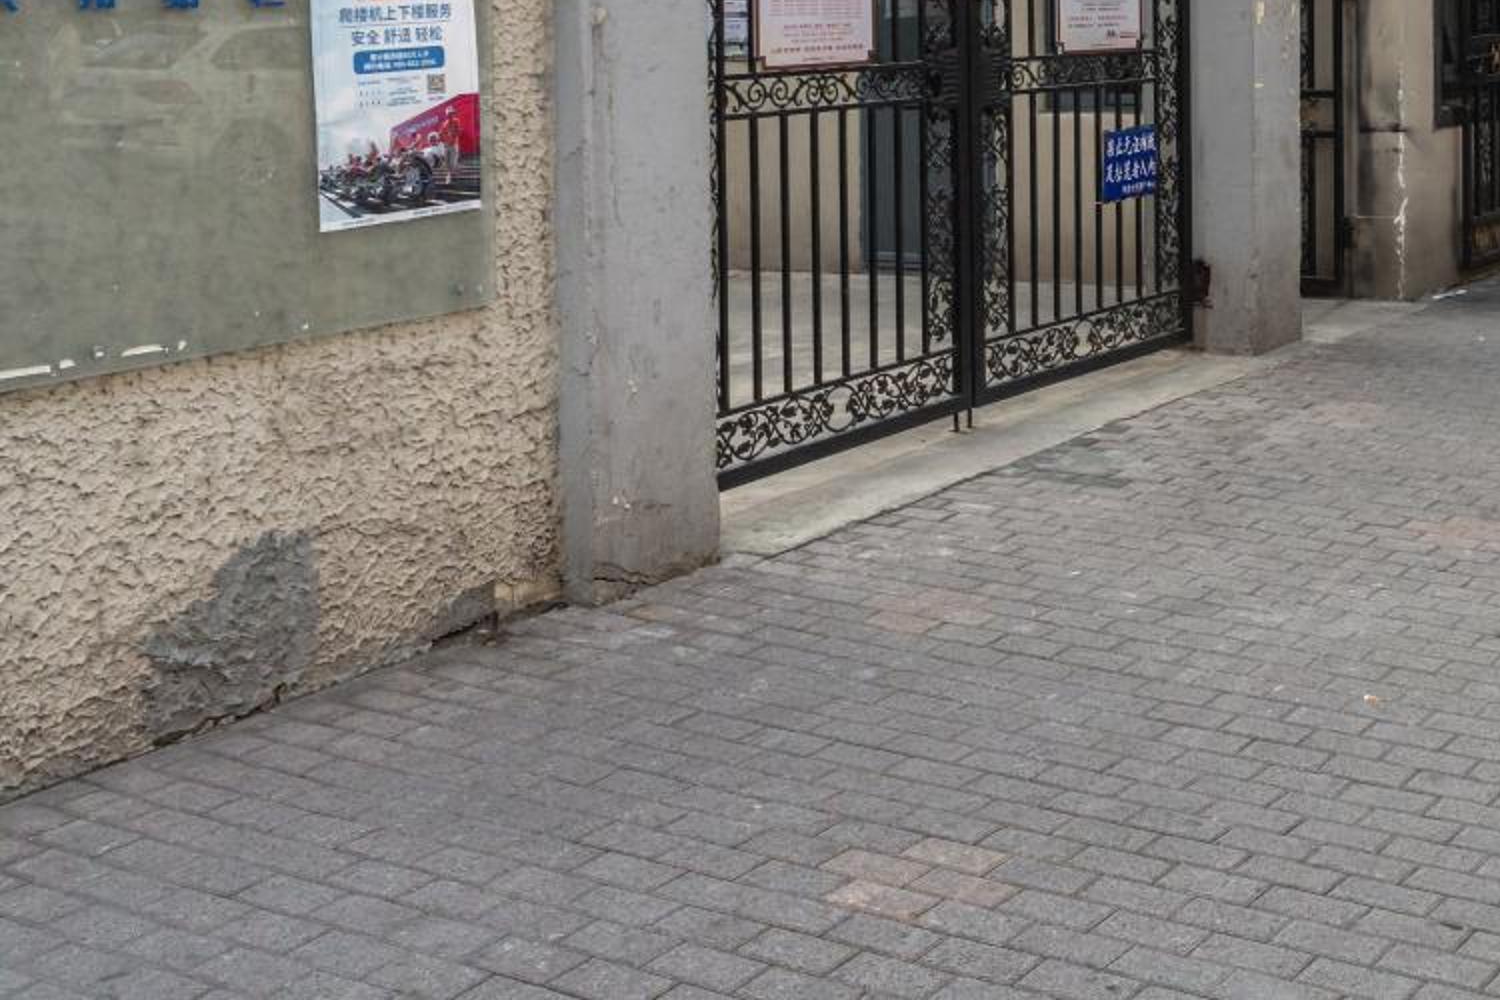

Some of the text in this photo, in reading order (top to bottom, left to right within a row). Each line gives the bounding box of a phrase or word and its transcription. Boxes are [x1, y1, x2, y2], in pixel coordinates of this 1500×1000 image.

[338, 2, 452, 24] 爬楼机上下楼服务
[352, 25, 443, 46] 安全 舒适 轻松
